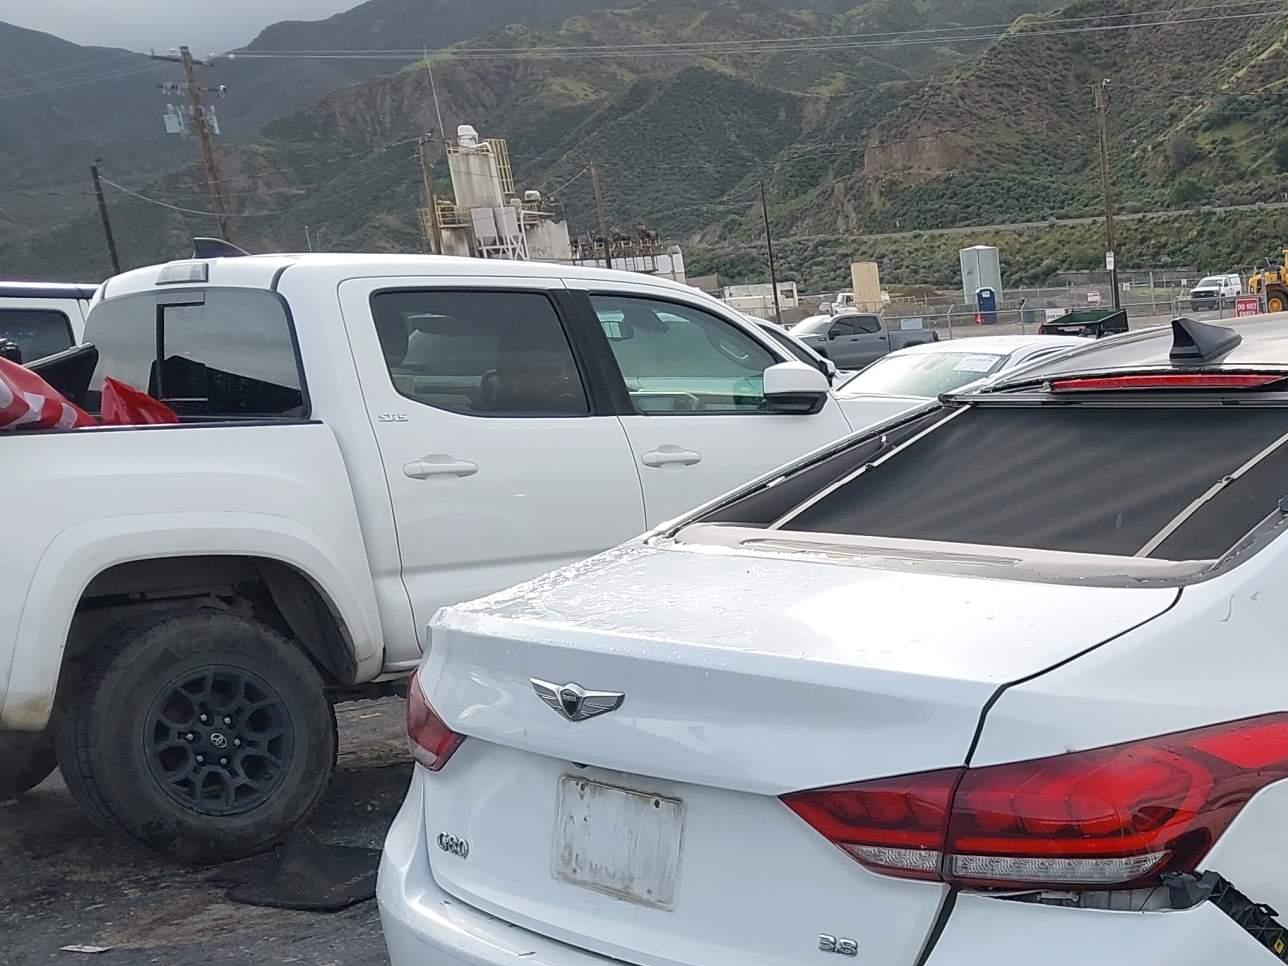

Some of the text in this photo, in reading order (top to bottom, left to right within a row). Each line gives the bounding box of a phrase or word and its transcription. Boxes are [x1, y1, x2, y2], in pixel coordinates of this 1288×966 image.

[1237, 302, 1257, 311] DO NOT
[437, 831, 470, 859] G80
[818, 933, 858, 957] 3.8
